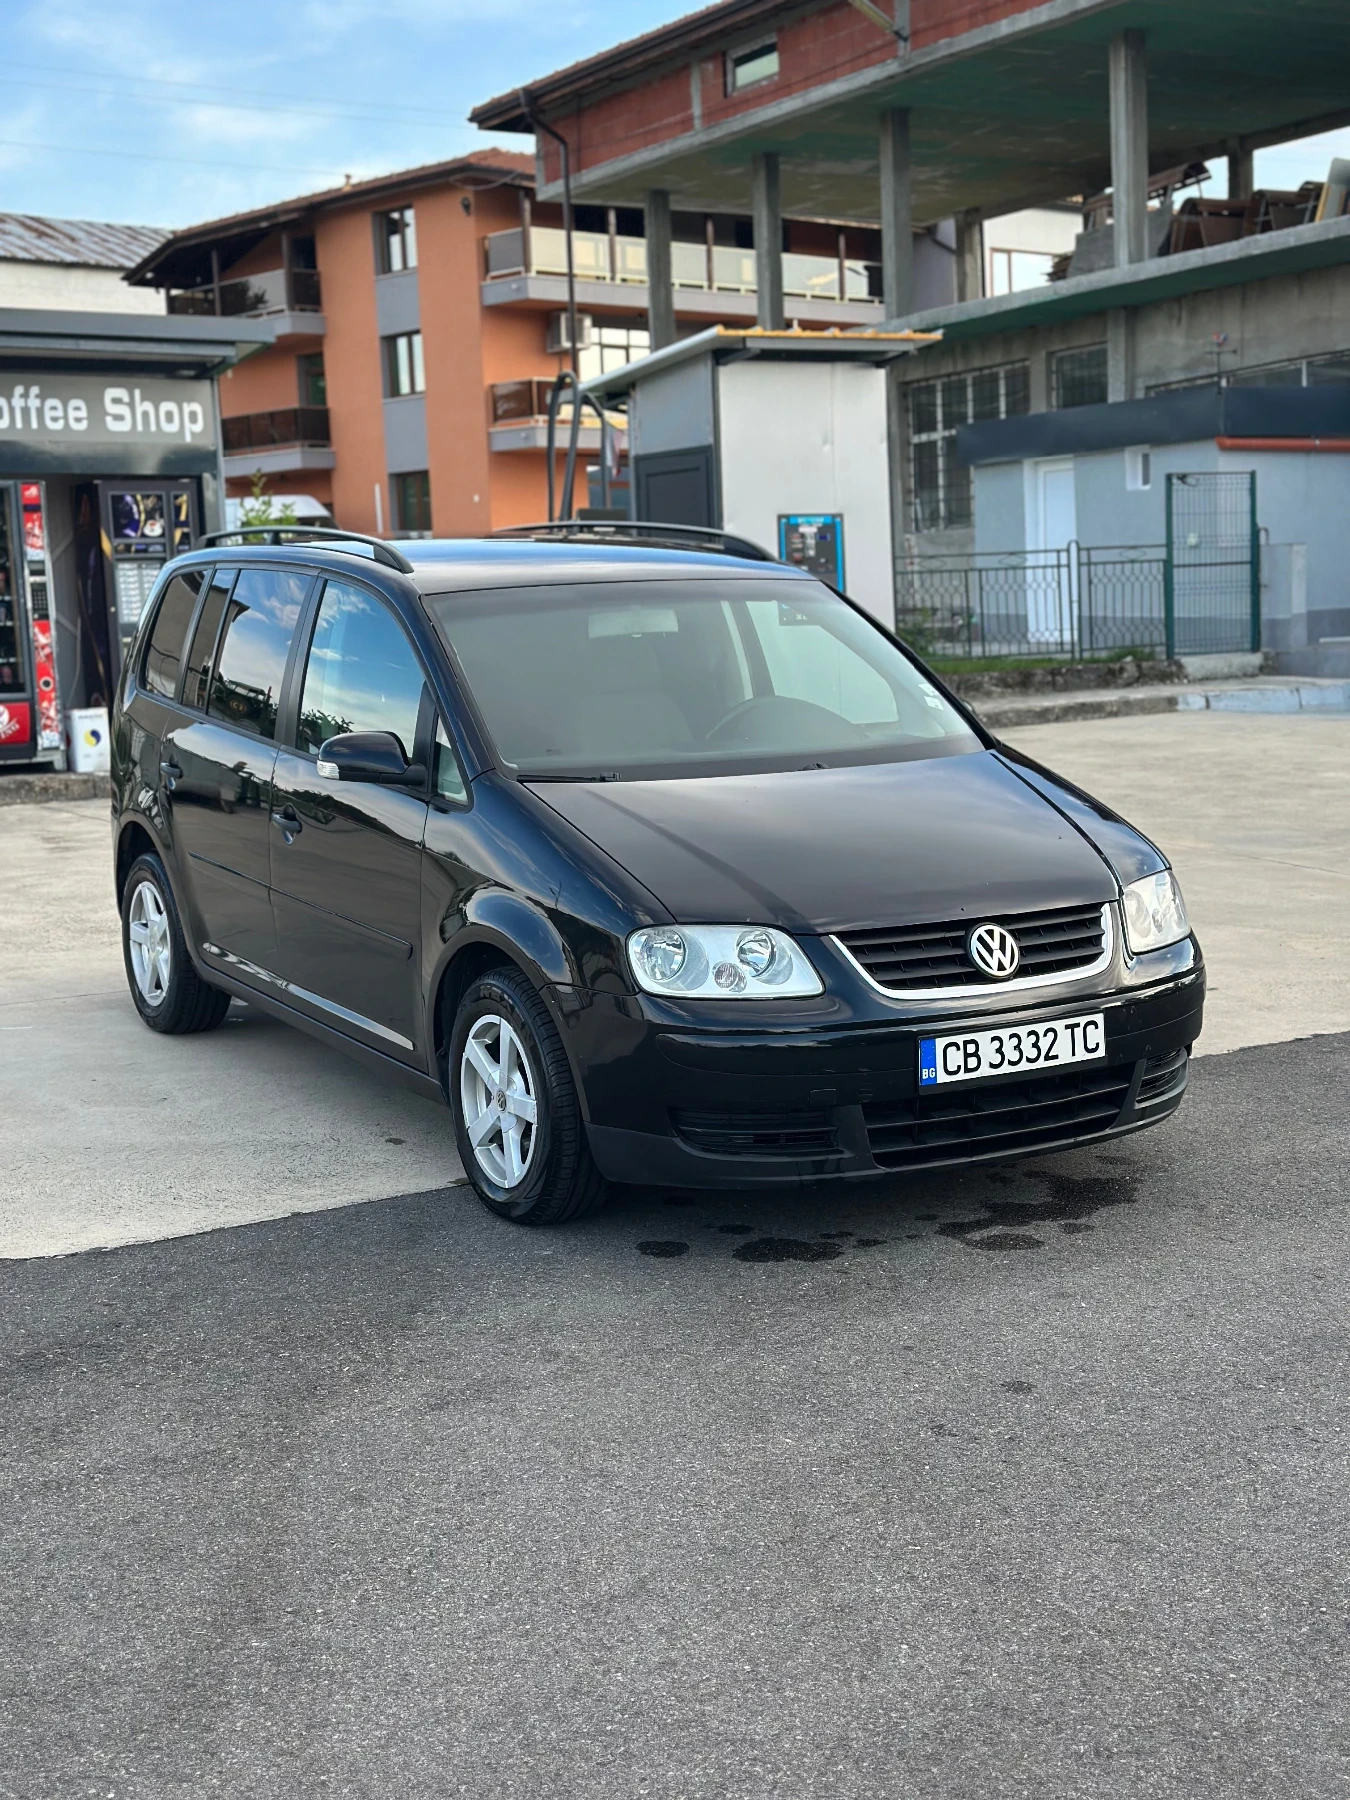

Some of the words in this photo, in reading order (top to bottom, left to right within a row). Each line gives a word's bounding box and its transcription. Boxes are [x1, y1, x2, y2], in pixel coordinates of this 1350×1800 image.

[103, 387, 204, 442] Shop
[970, 924, 1019, 977] VW
[922, 1068, 936, 1079] BG
[942, 1039, 982, 1076] CB
[988, 1027, 1059, 1069] 3332
[1064, 1020, 1100, 1057] TC
